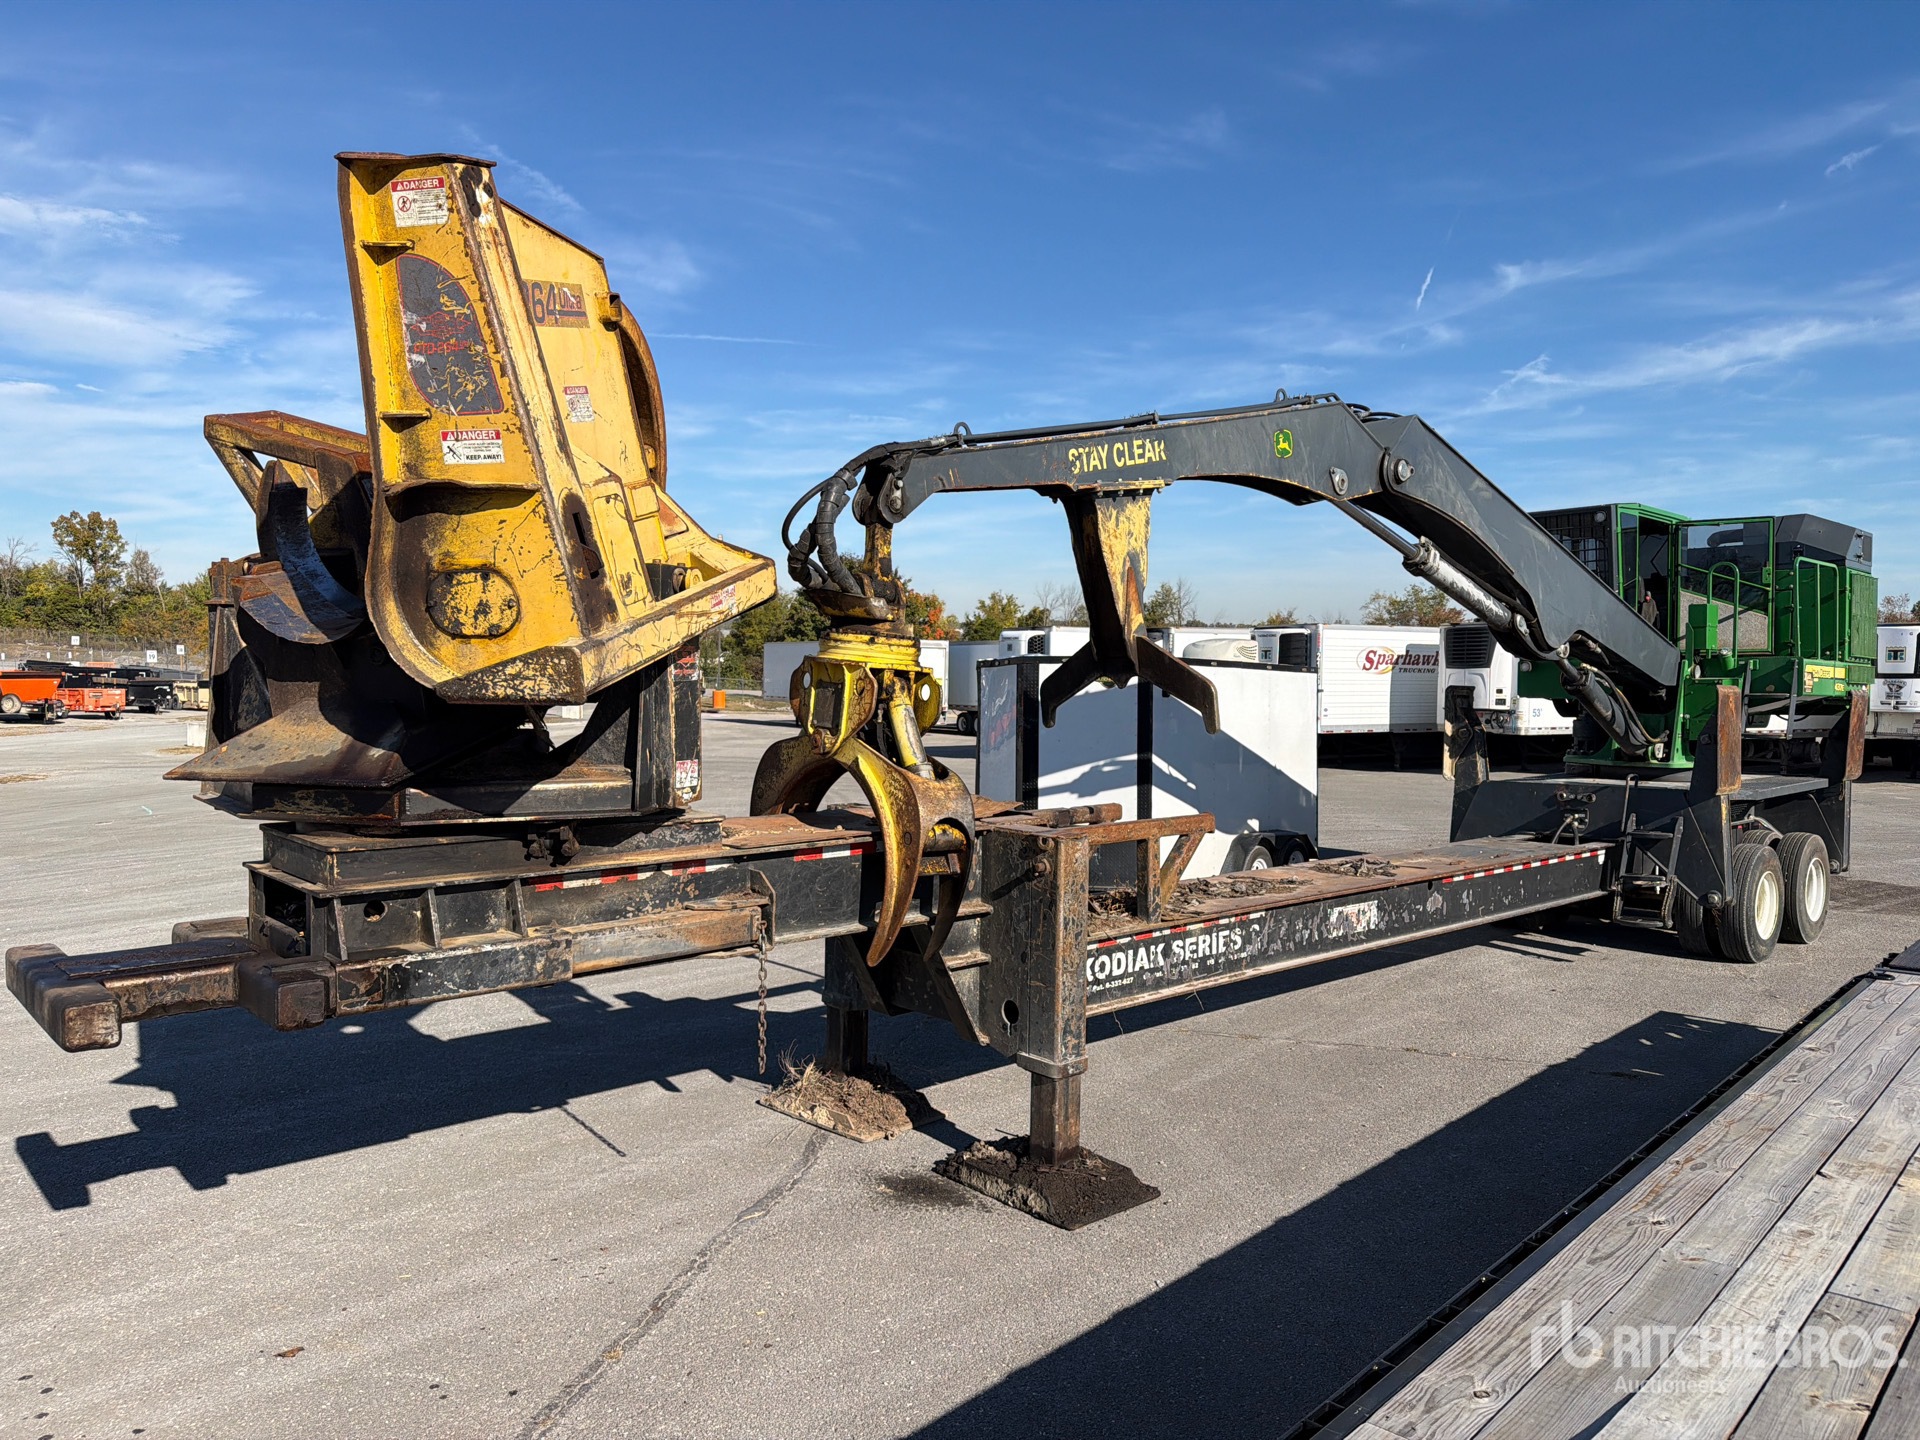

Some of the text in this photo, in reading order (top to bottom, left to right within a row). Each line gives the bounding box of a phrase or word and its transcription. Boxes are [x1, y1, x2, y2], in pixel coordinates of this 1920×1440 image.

[403, 179, 440, 190] DANGER
[454, 430, 497, 440] DANGER
[1068, 438, 1167, 475] STAY CLEAR
[1171, 927, 1242, 962] SERIES
